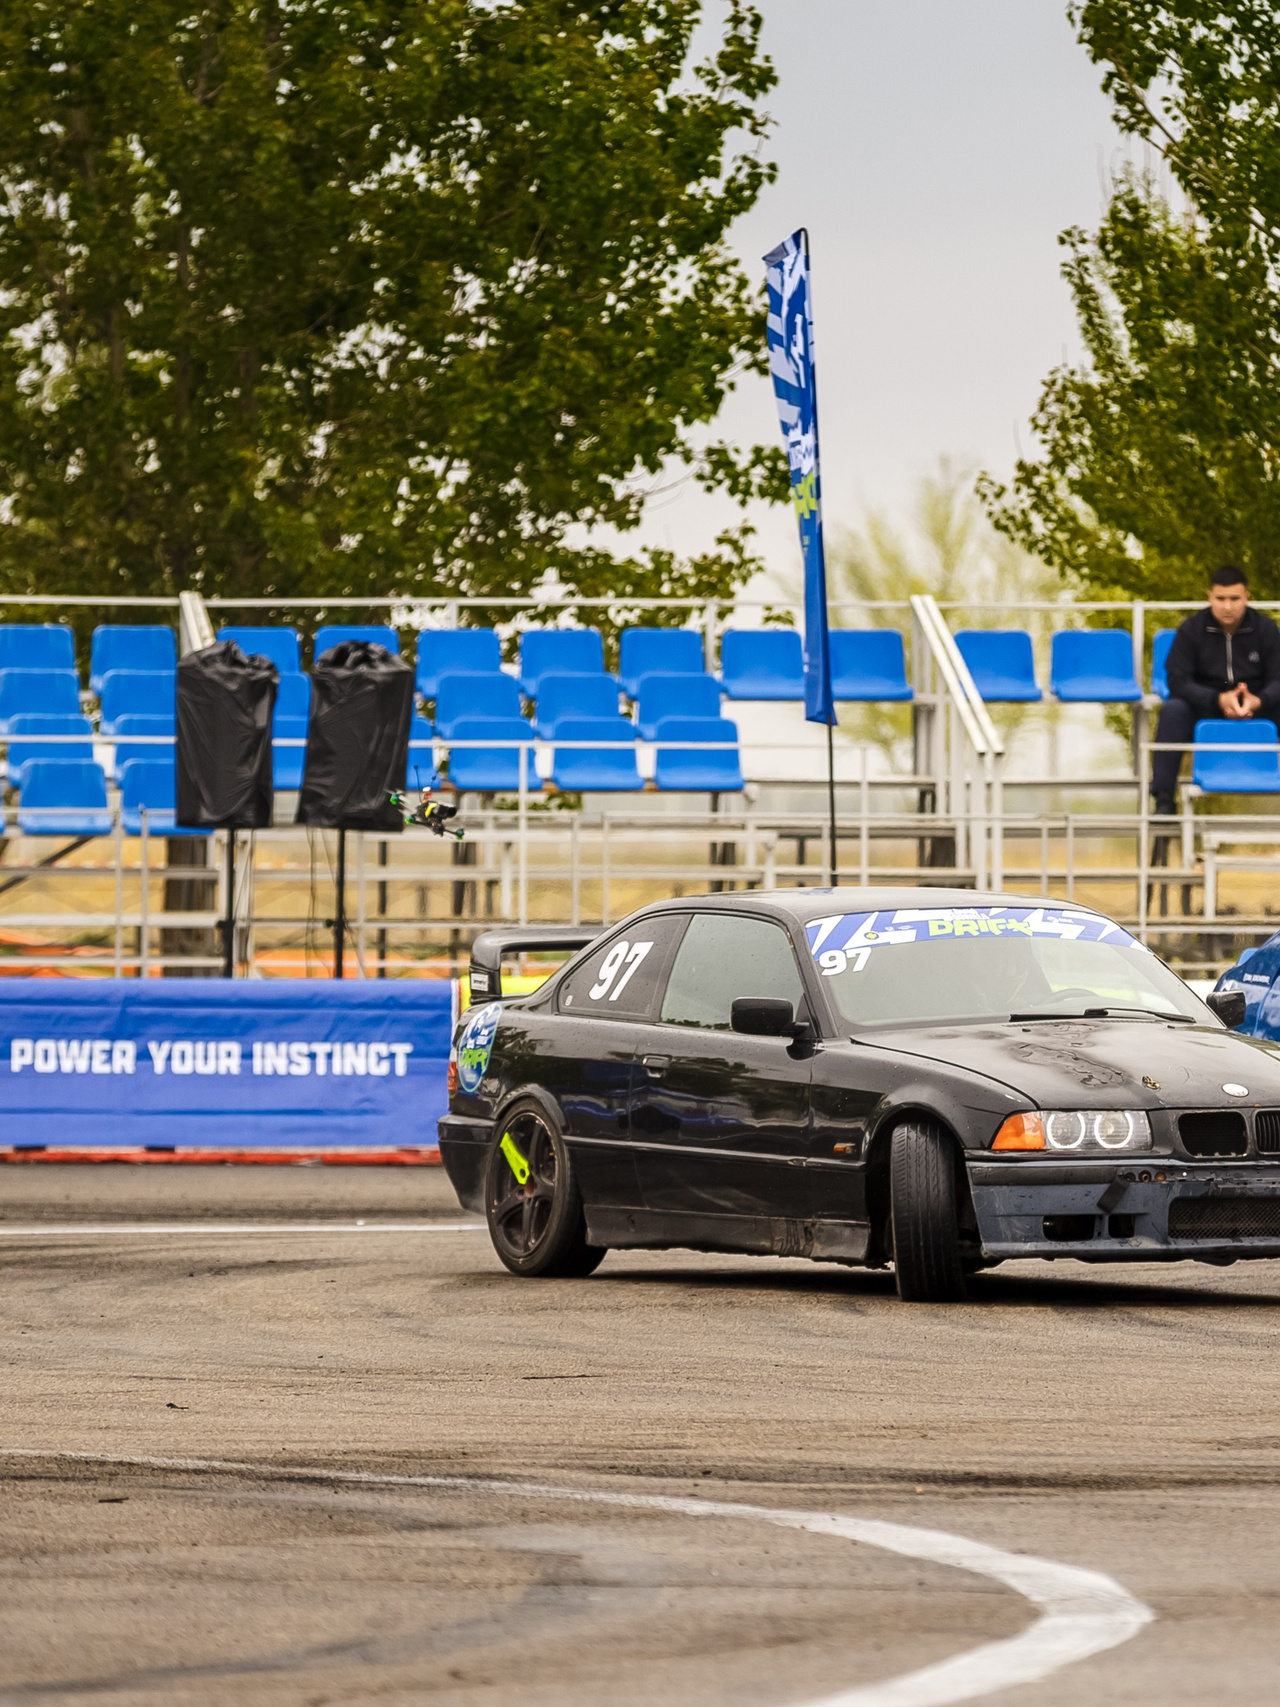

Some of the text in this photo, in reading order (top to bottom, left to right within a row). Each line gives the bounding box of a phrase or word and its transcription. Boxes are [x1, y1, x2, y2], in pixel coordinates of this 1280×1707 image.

[589, 941, 655, 1001] 97
[819, 947, 872, 976] 97
[10, 1038, 414, 1078] POWER YOUR INSTINCT
